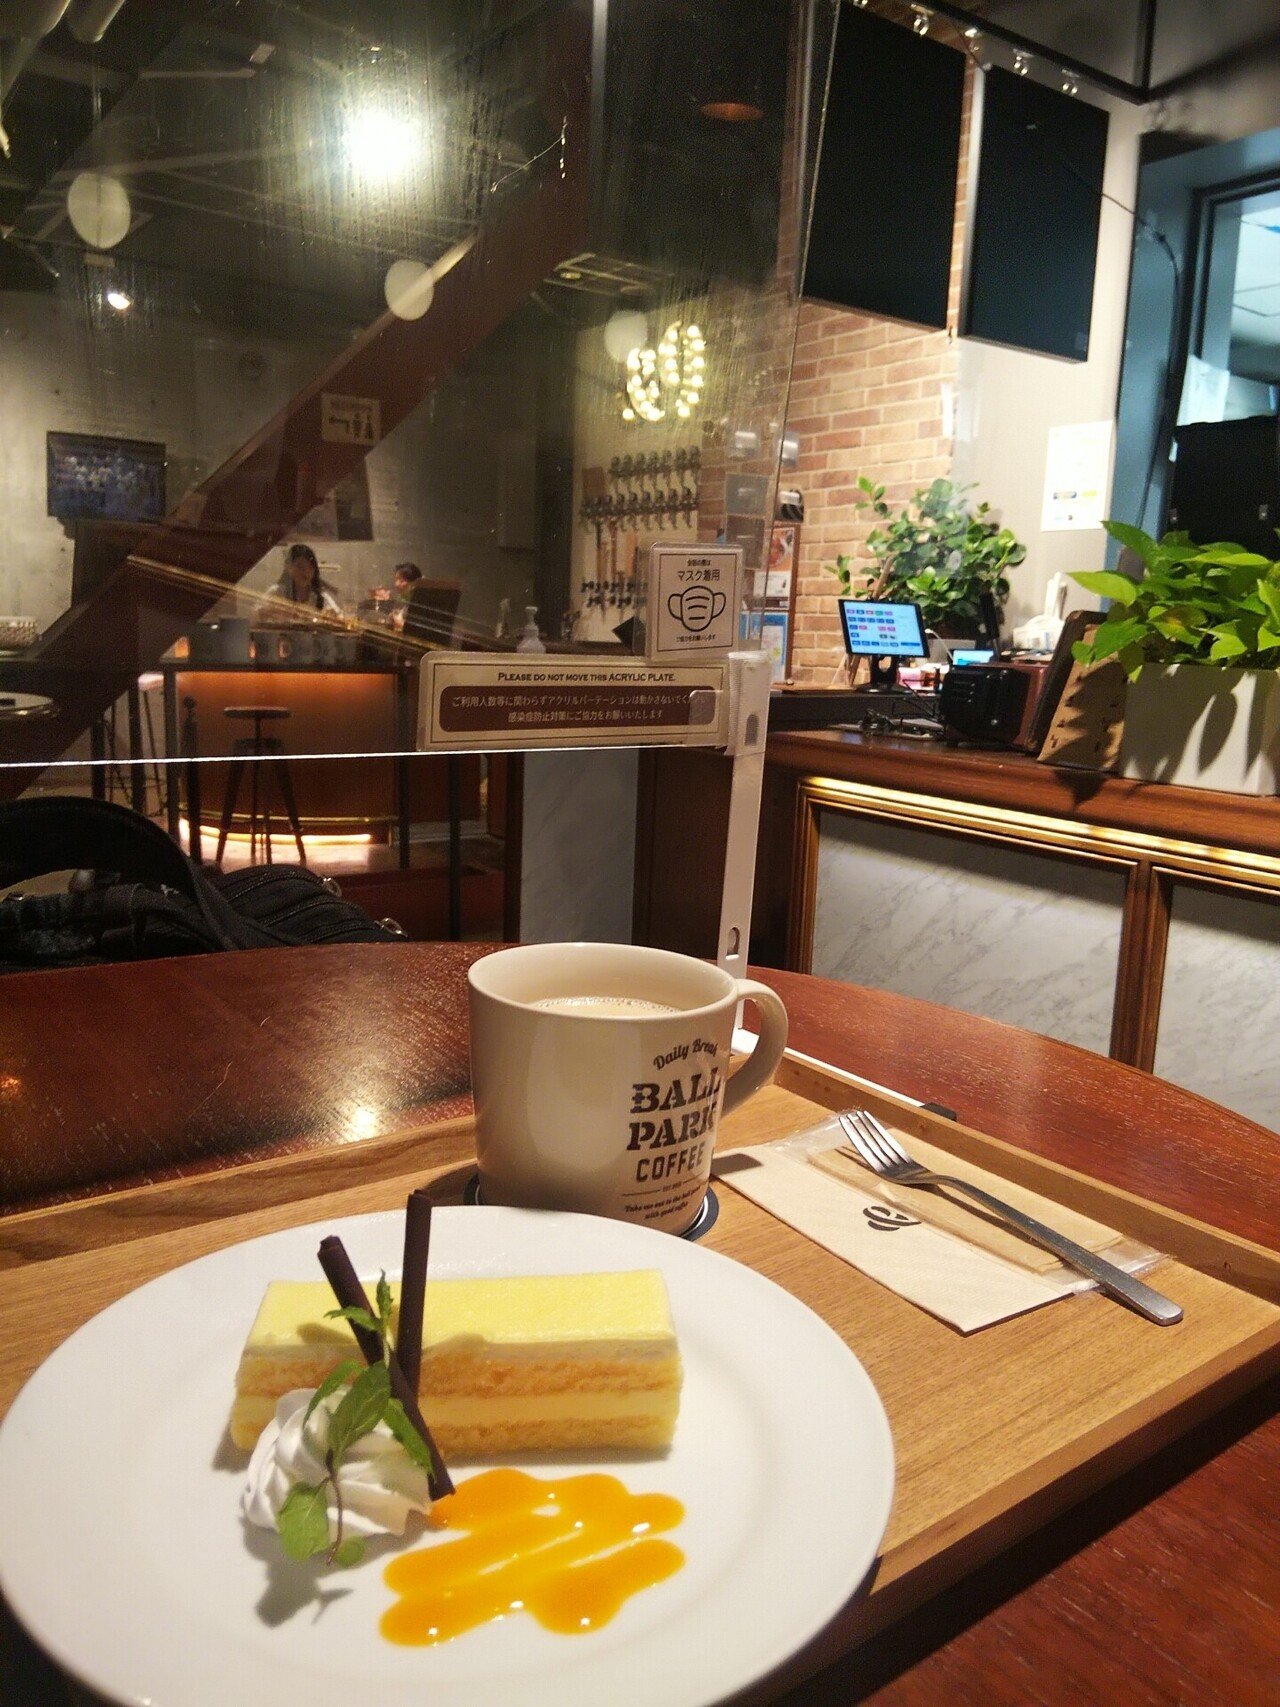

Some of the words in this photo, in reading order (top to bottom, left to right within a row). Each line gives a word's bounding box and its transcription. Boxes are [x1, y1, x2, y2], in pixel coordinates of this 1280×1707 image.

[677, 569, 720, 581] マスク着用
[498, 672, 532, 681] PLEASE
[533, 673, 546, 681] DO
[547, 673, 564, 681] NOT
[565, 673, 588, 681] MOVE
[609, 673, 646, 682] ACRYLIC
[653, 1044, 690, 1070] Daily
[630, 1066, 722, 1114] BALL
[626, 1101, 718, 1150] PARK
[636, 1141, 706, 1183] COFFEE
